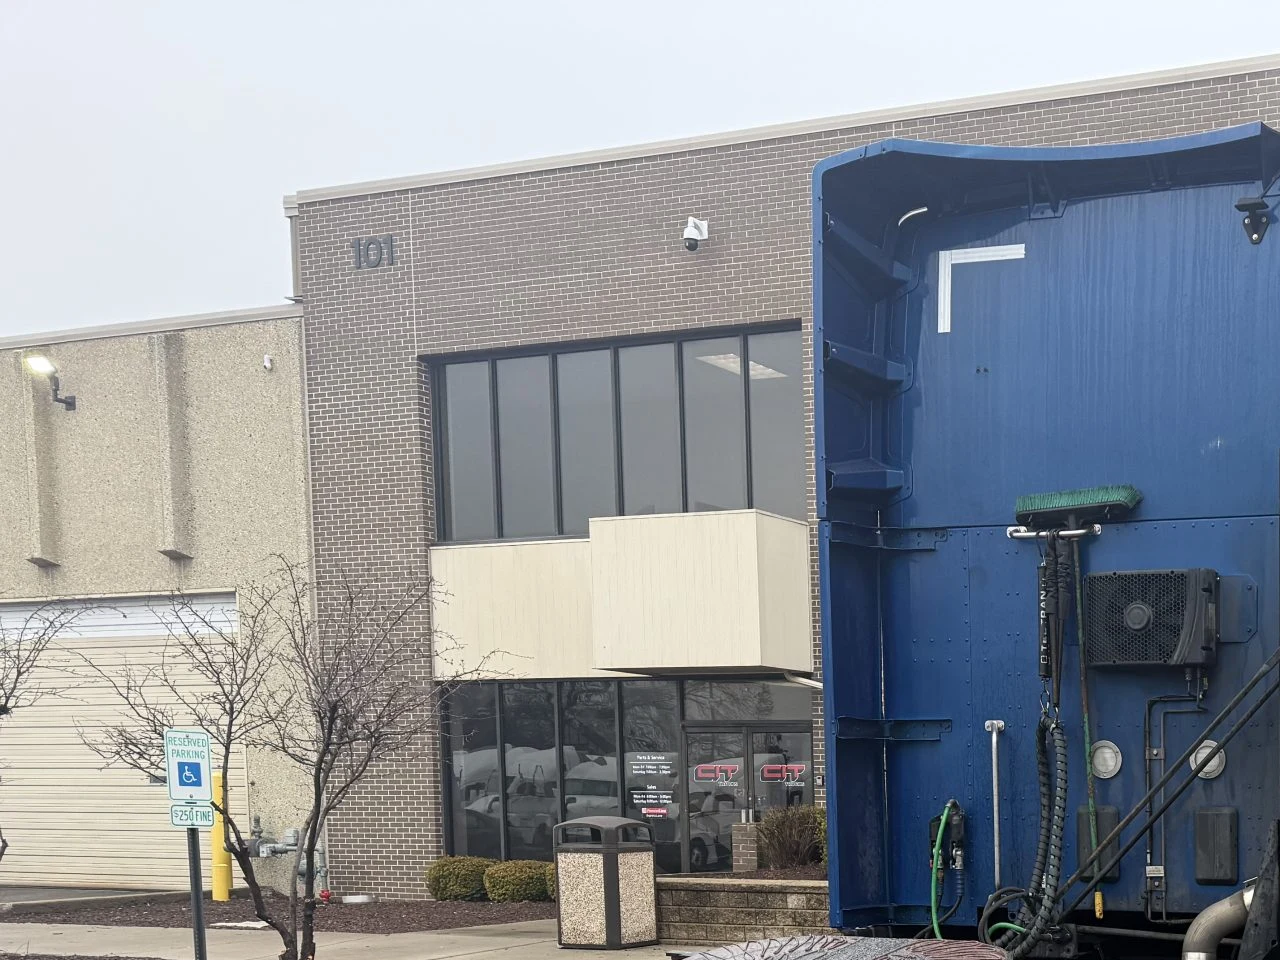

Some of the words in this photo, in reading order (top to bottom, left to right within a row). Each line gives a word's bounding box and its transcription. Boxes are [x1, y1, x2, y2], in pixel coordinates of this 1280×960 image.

[349, 233, 394, 270] 101
[168, 736, 207, 748] RESERVED
[171, 748, 206, 760] PARKING
[693, 764, 739, 782] CIT
[759, 764, 806, 782] CIT
[173, 809, 195, 822] $250
[195, 810, 212, 822] FINE
